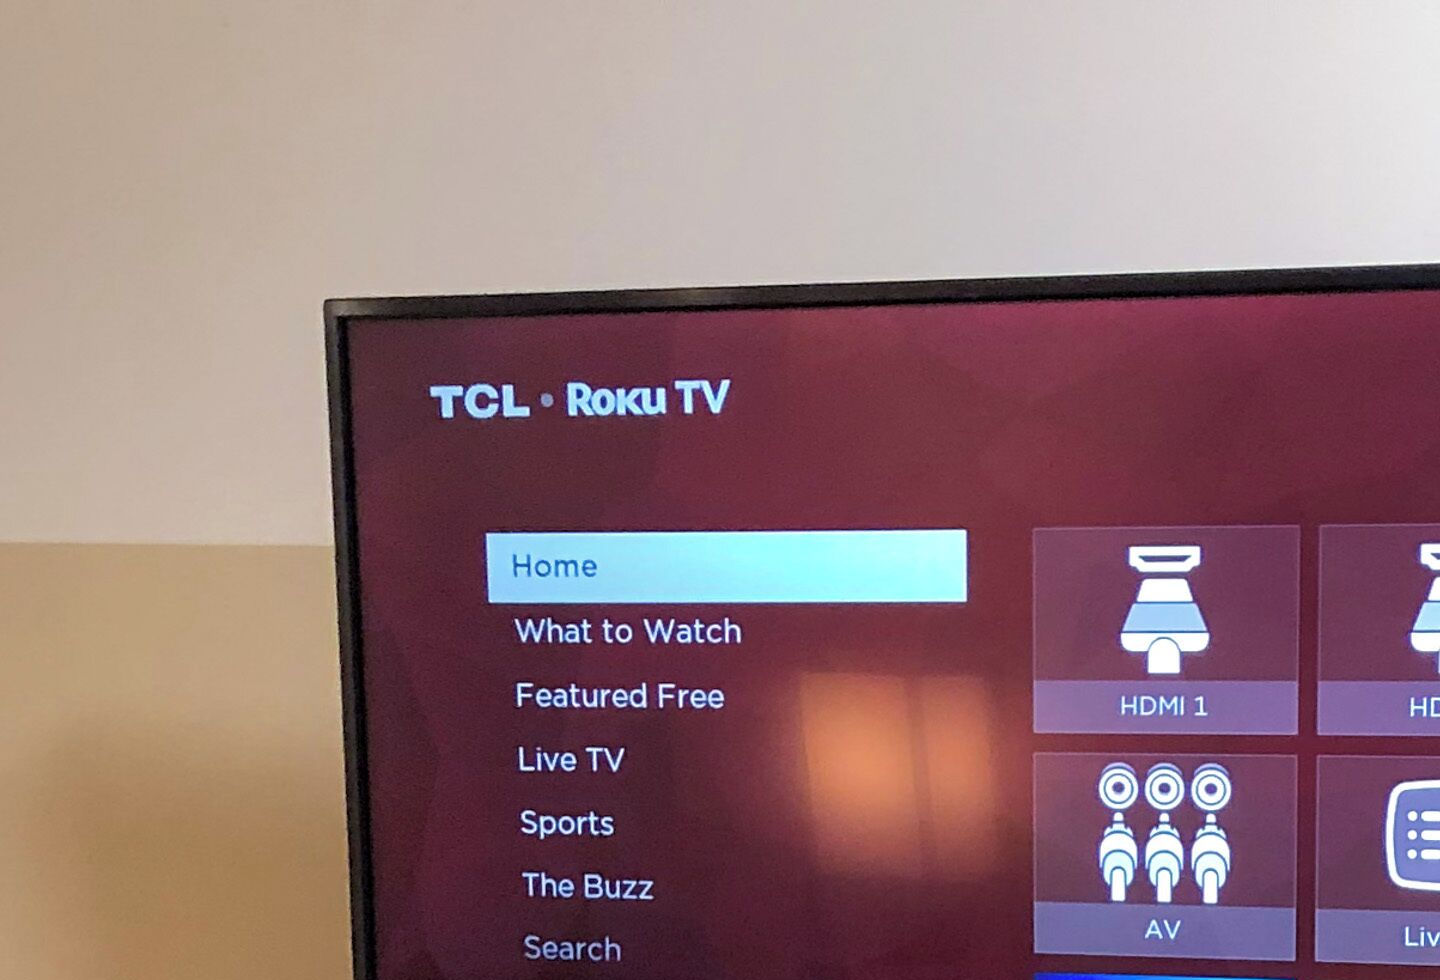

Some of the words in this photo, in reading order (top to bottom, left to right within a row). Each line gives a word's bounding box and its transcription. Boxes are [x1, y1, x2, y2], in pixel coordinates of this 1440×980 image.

[430, 384, 530, 419] TCL
[674, 379, 731, 415] TV
[512, 553, 598, 578] Home
[514, 618, 593, 644] What
[602, 620, 633, 644] to
[643, 618, 742, 643] Watch
[515, 683, 648, 709] Featured
[657, 684, 725, 708] Free
[1120, 696, 1186, 716] HDMI
[1194, 696, 1208, 716] 1
[518, 746, 577, 772] Live
[585, 747, 625, 772] TV
[520, 810, 615, 839] Sports
[522, 872, 575, 898] The
[583, 874, 655, 900] Buzz
[1145, 920, 1181, 940] AV
[523, 935, 622, 962] Search
